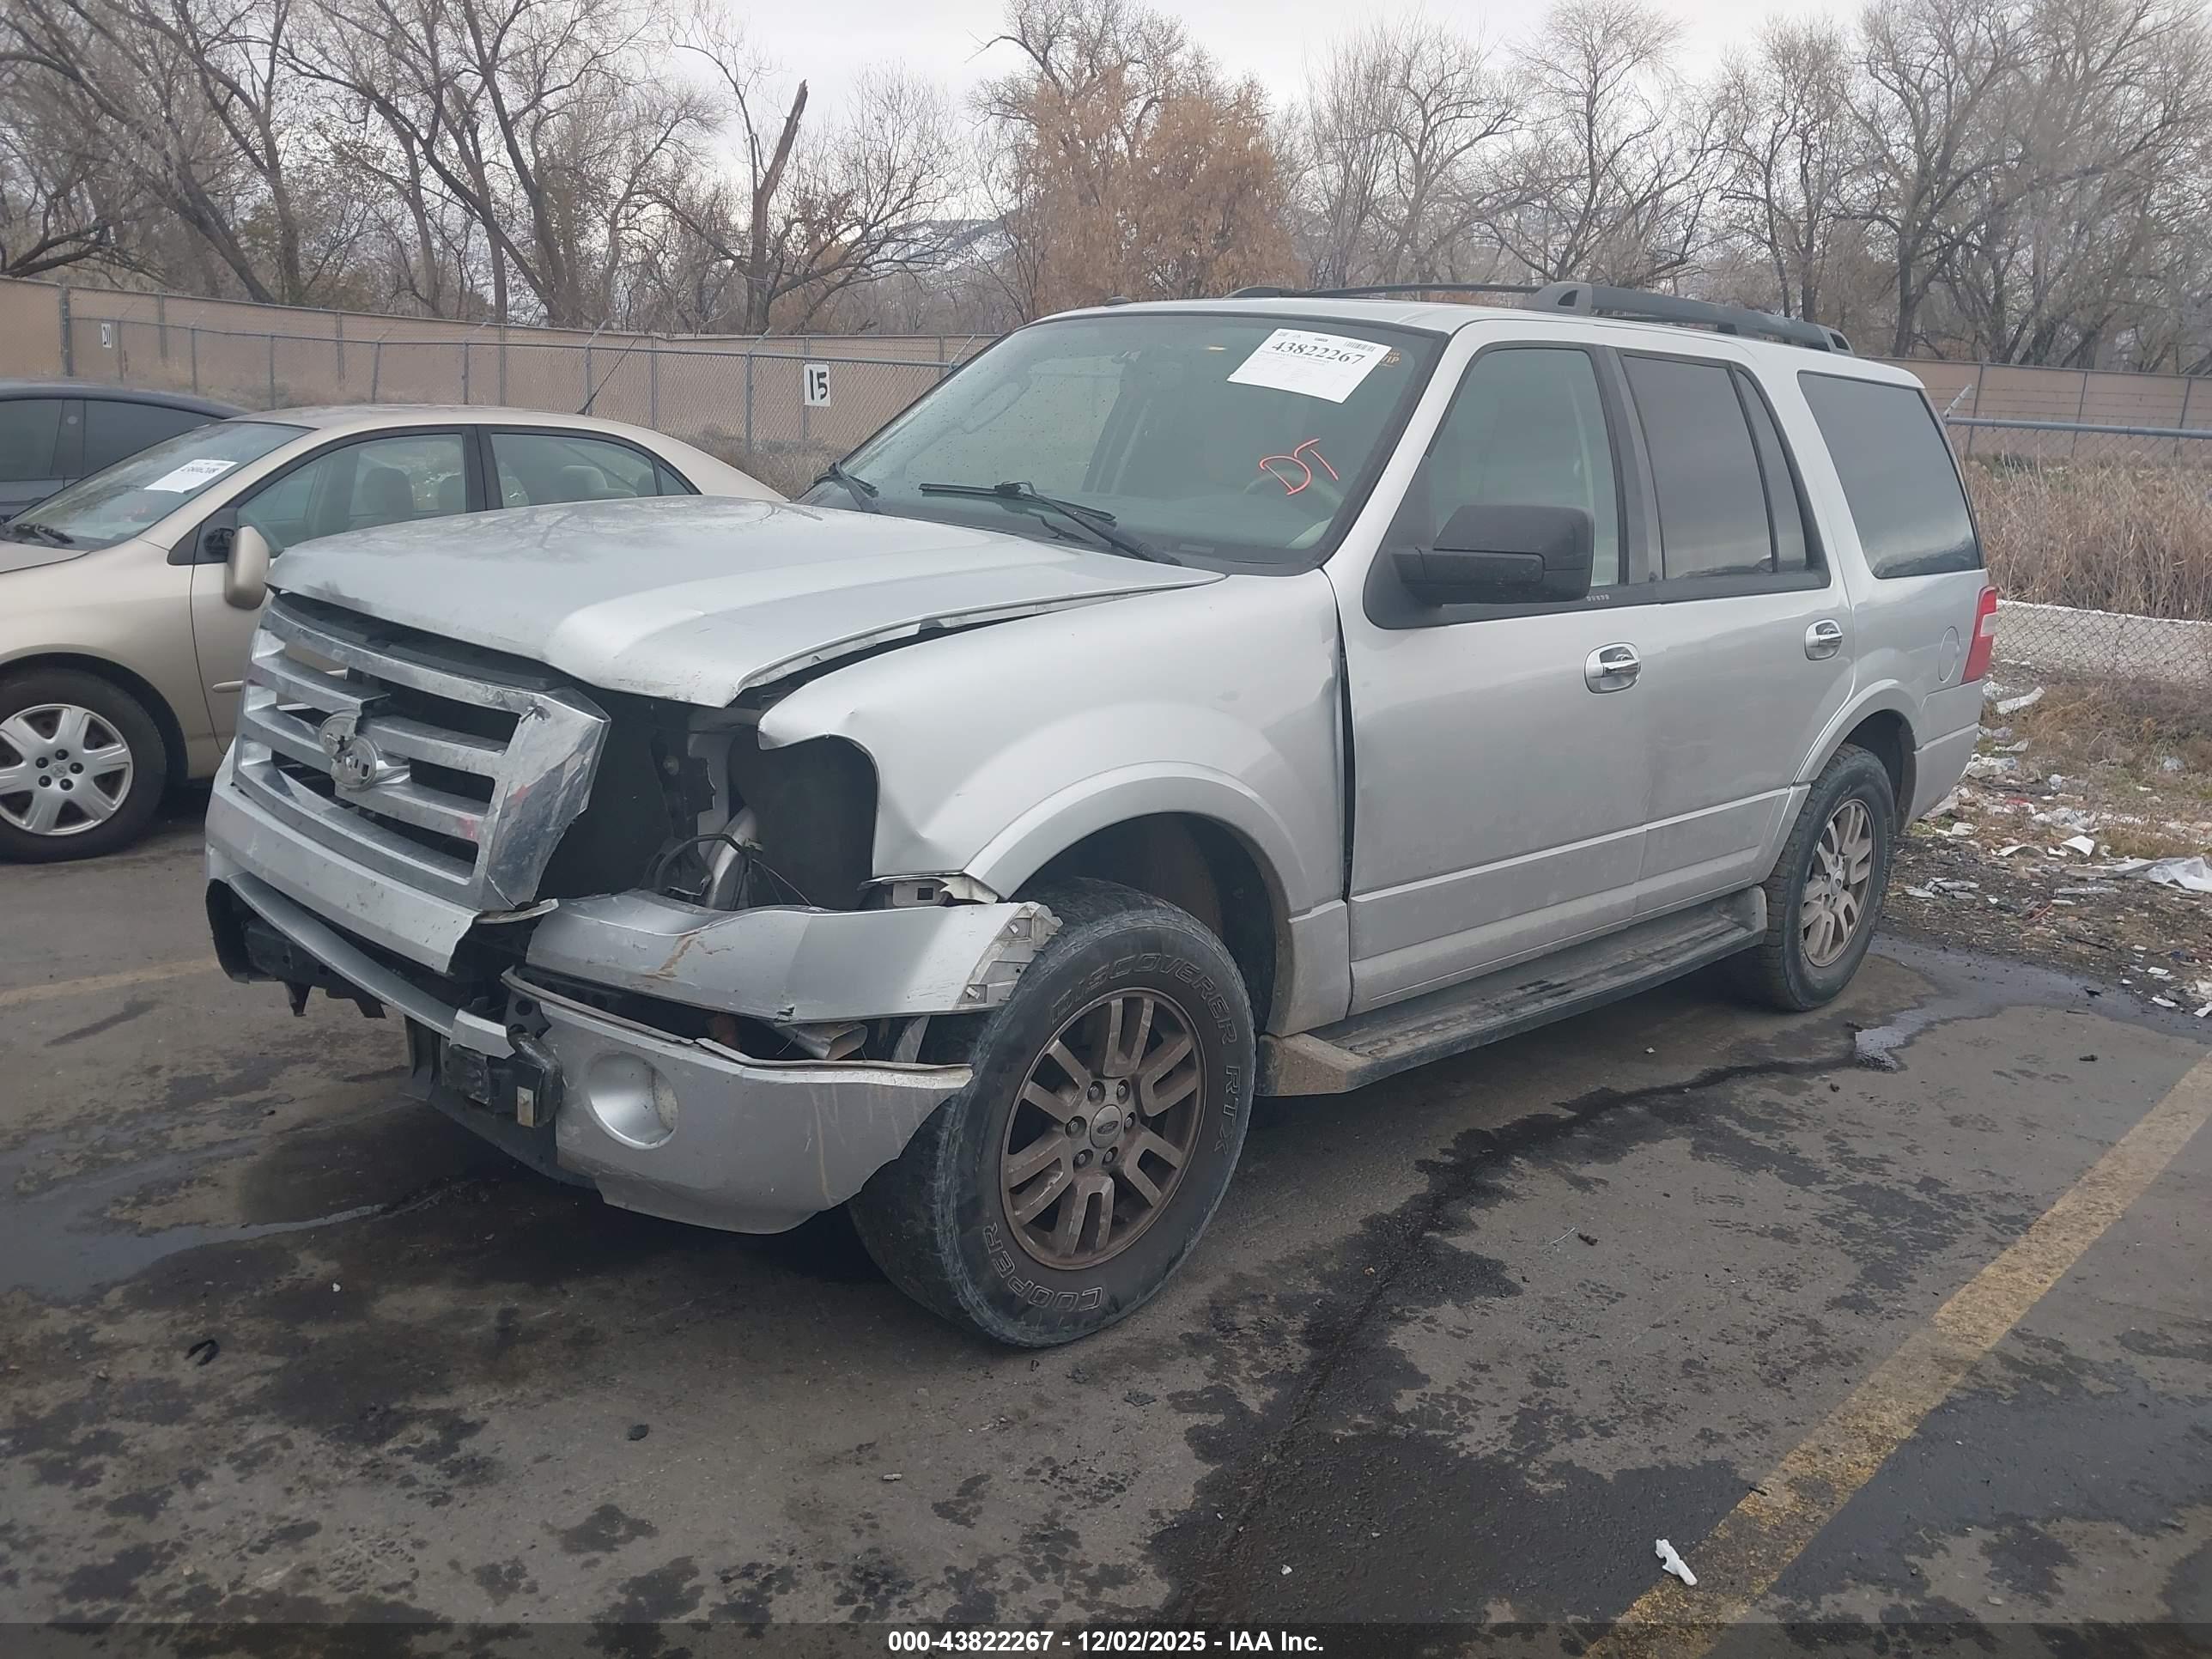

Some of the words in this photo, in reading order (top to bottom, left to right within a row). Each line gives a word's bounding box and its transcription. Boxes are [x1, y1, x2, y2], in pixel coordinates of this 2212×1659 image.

[103, 325, 111, 346] 20
[1272, 341, 1366, 365] 43822267
[809, 369, 828, 401] 15
[1050, 952, 1237, 1045] DISCOVERER
[982, 1222, 1103, 1312] COOPER
